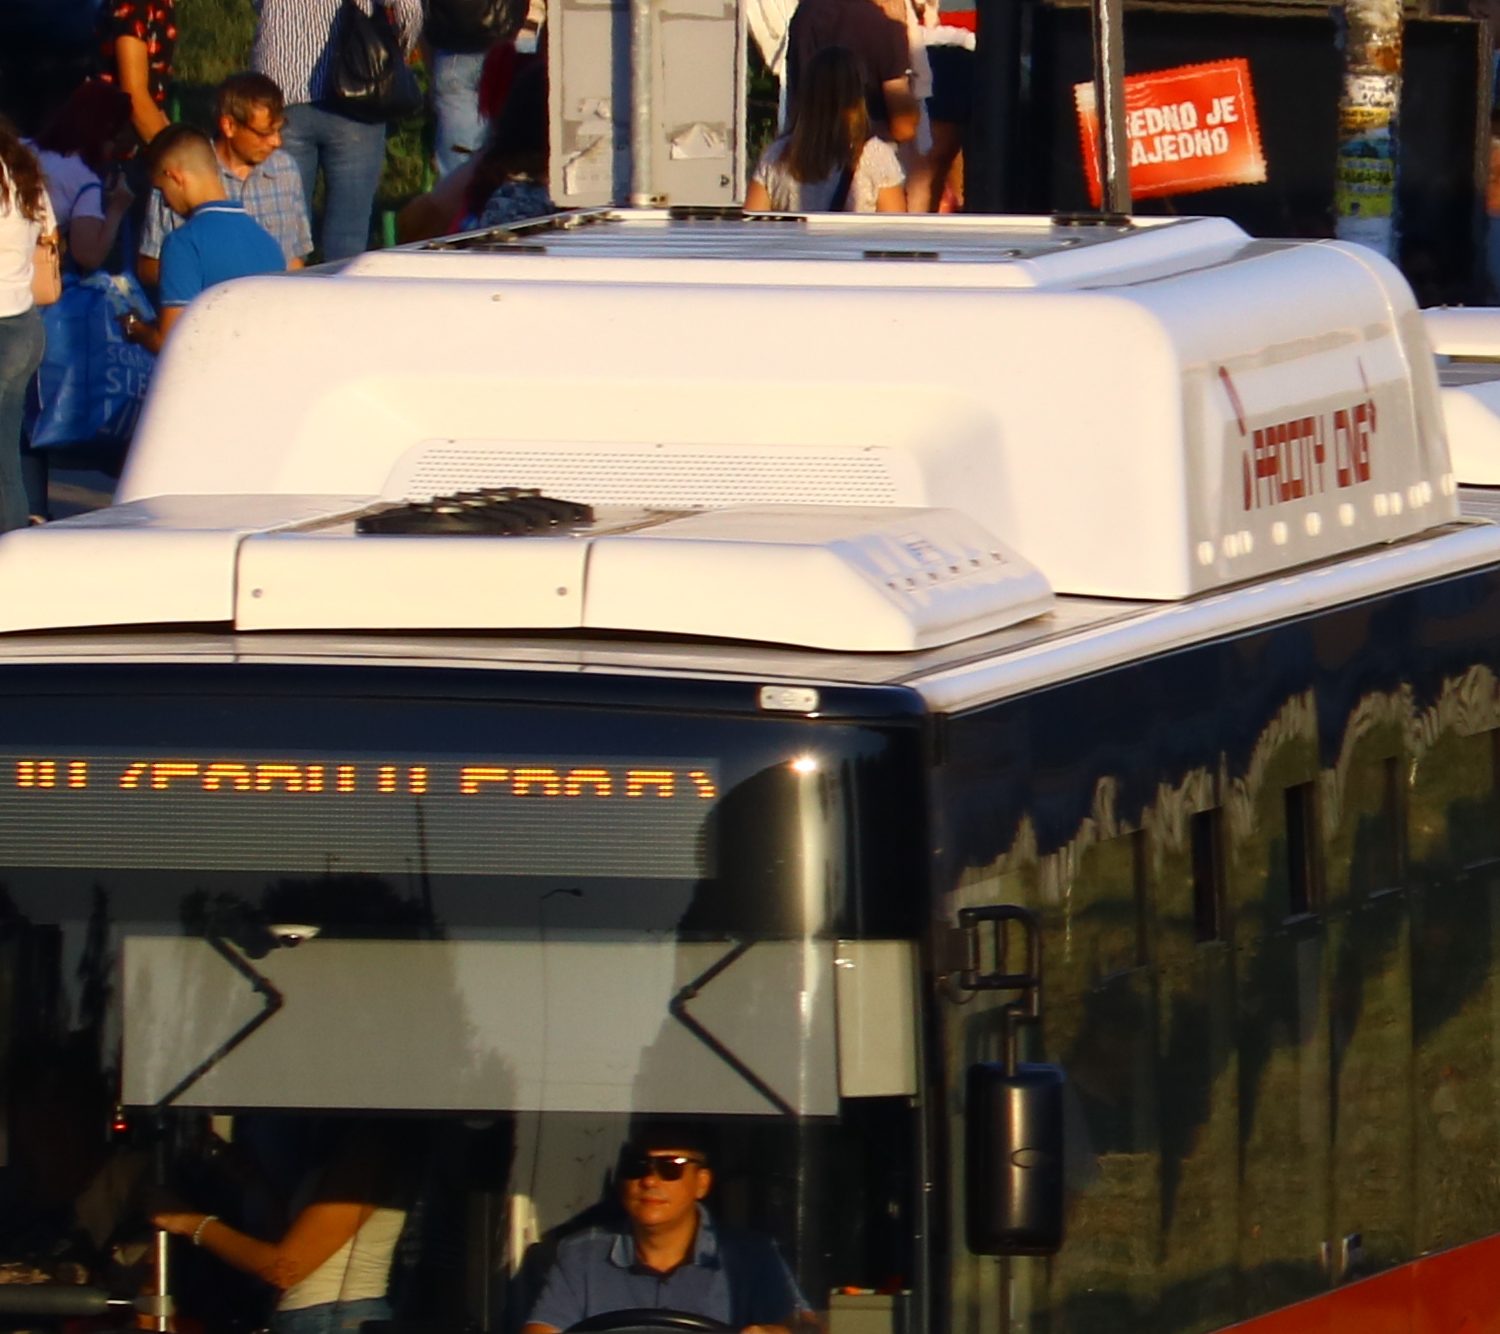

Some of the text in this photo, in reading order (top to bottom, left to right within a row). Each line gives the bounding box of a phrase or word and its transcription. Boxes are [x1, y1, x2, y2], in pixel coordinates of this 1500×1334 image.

[1127, 95, 1239, 138] EDNO JE
[1131, 127, 1230, 167] AJEDNO
